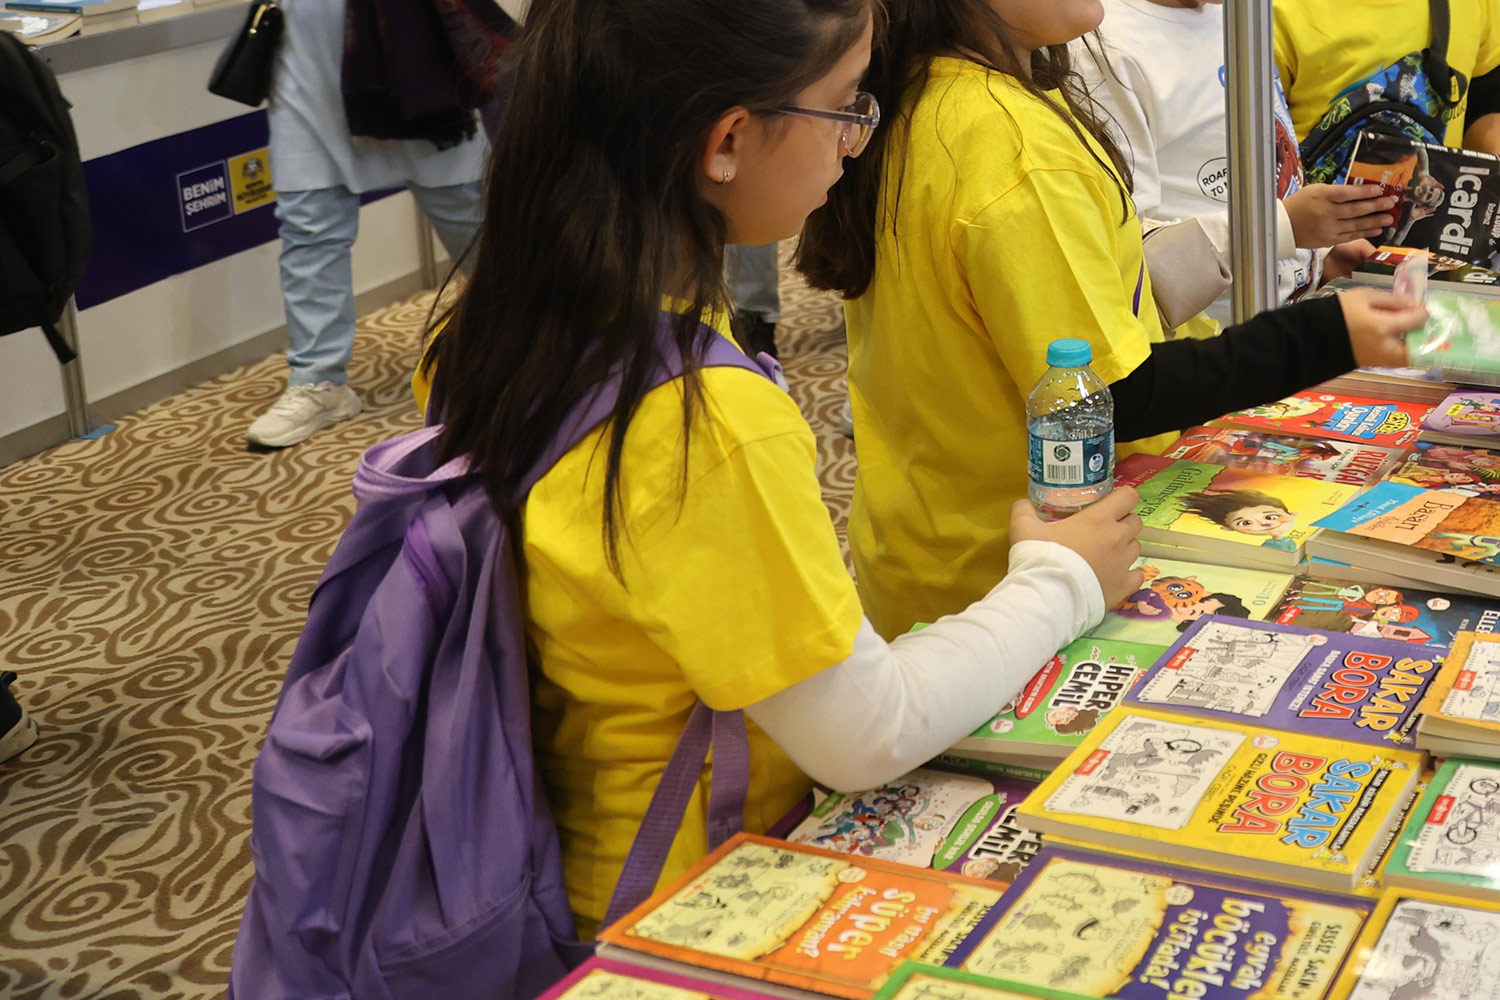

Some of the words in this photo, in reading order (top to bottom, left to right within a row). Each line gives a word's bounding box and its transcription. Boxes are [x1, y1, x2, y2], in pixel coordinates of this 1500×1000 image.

[183, 176, 225, 201] BENİM
[1211, 185, 1224, 197] TO
[1439, 165, 1491, 257] Icardi
[1298, 650, 1393, 721] BORA
[1355, 657, 1435, 731] SAKAR
[1218, 751, 1327, 835] BORA
[1229, 770, 1255, 795] HAZİNE
[1248, 752, 1269, 771] GİZLİ
[1208, 795, 1236, 825] PEŞİNDE
[1279, 758, 1372, 848] SAKAR
[826, 887, 917, 961] süper
[1140, 908, 1210, 991] istilada!
[1314, 923, 1342, 956] SESSİZ
[1229, 931, 1278, 991] eyvah
